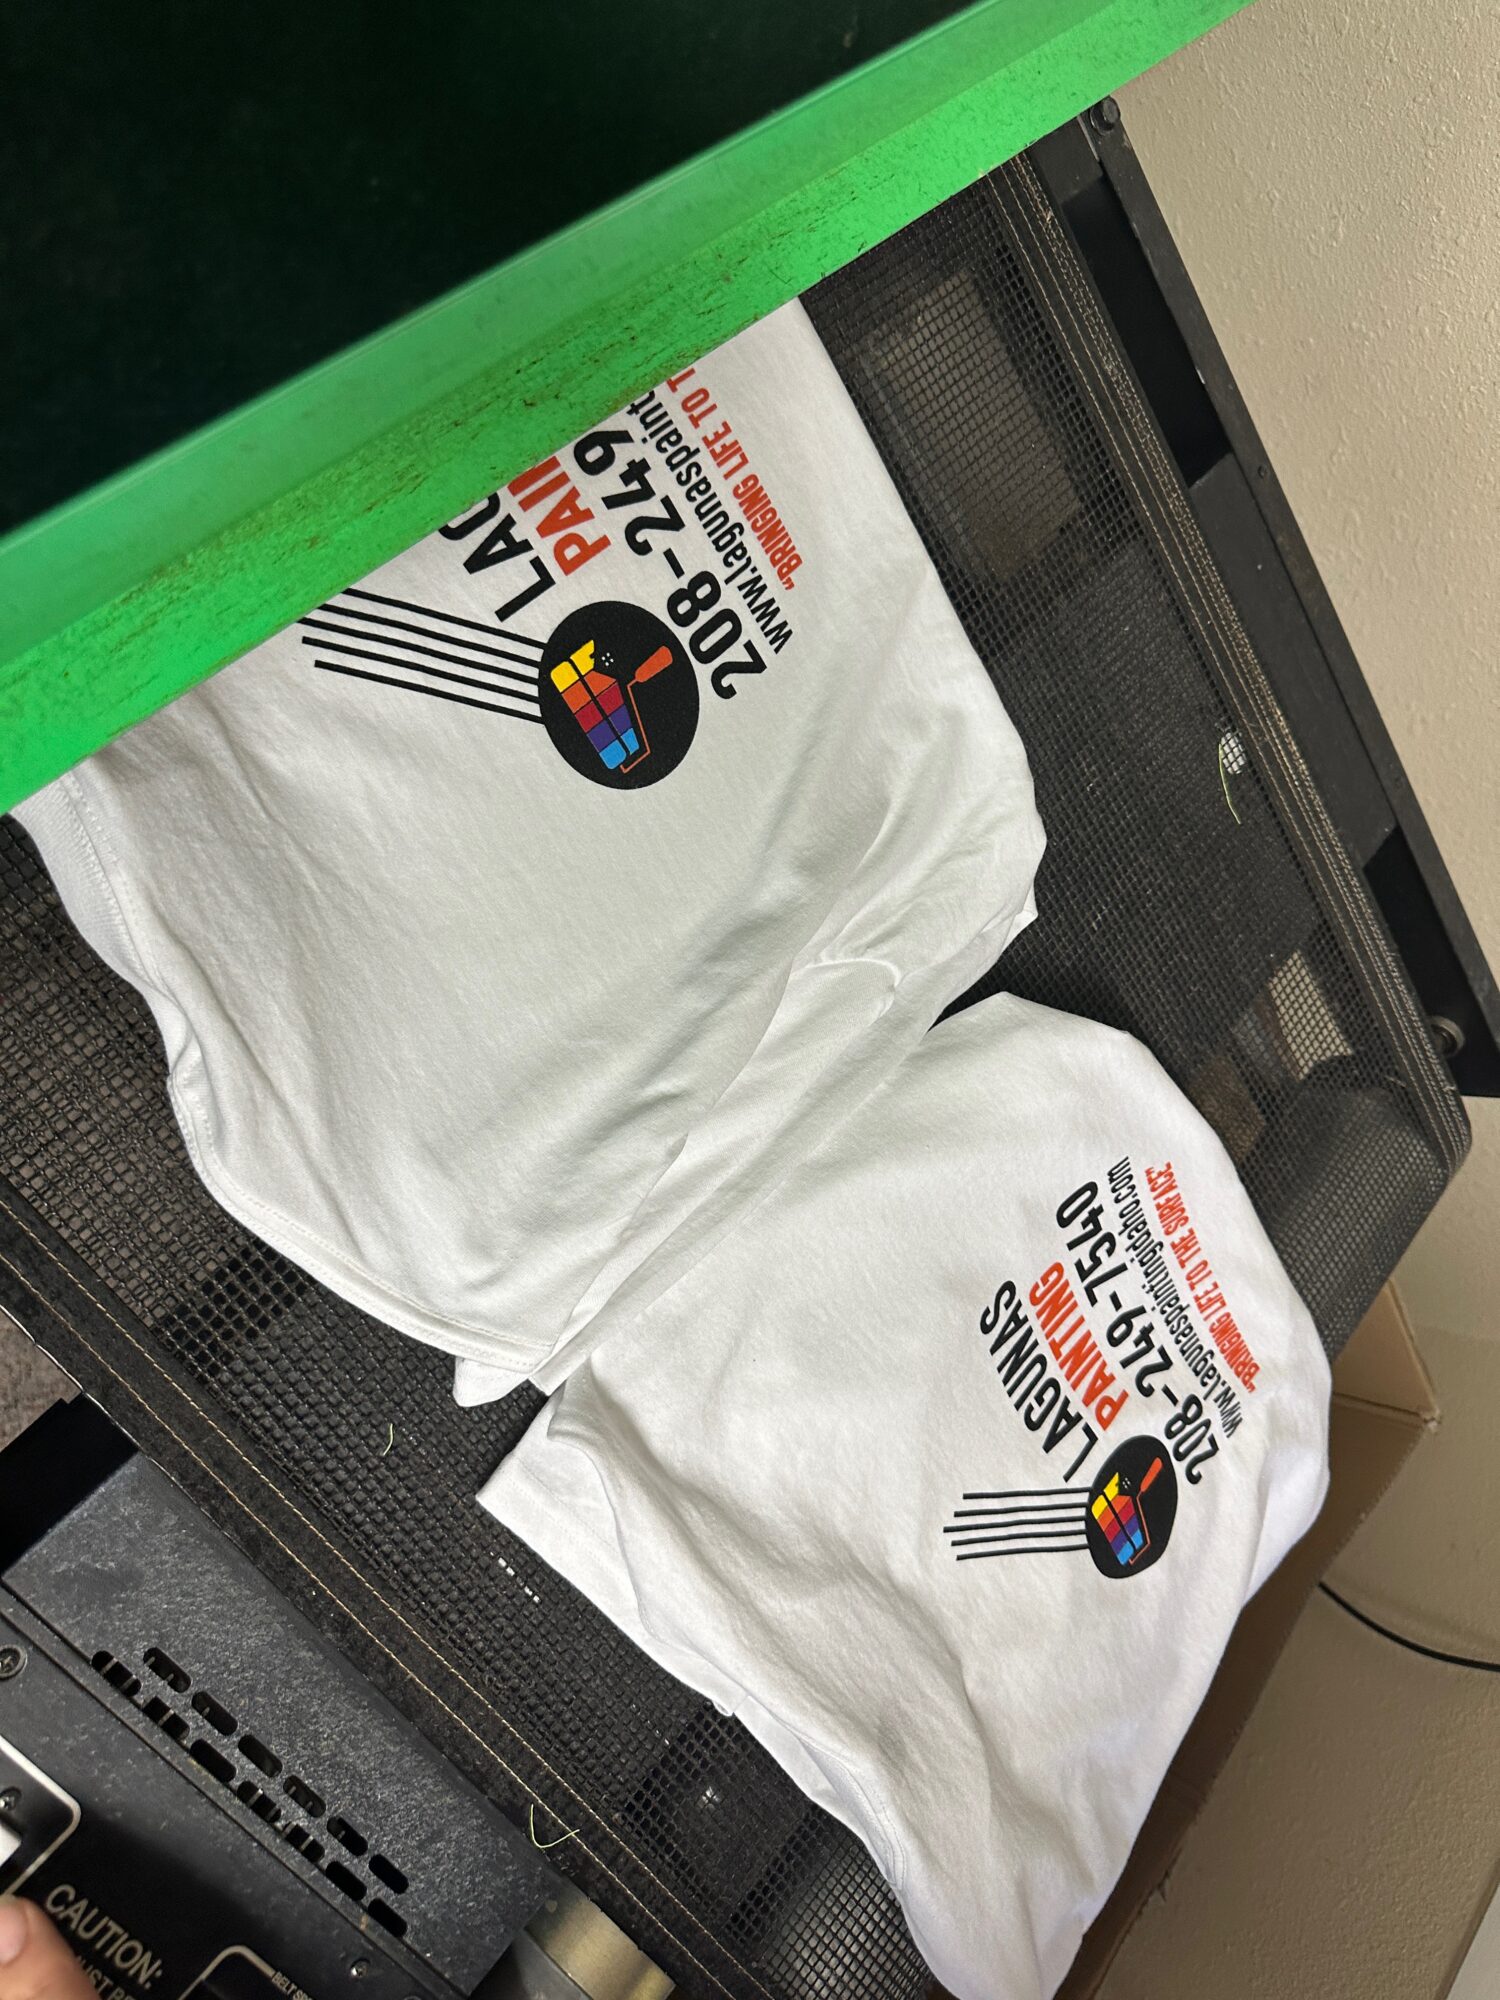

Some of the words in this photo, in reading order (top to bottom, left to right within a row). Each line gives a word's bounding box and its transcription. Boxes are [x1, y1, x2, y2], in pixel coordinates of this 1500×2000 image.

[681, 387, 718, 429] TO
[702, 421, 749, 480] LIFE
[1170, 1227, 1202, 1269] THE
[1107, 1156, 1244, 1438] www.lagunaspaintingidaho.com
[1185, 1259, 1213, 1291] TO
[1193, 1281, 1227, 1322] LIFE
[1029, 1261, 1130, 1432] PAINTING
[979, 1279, 1099, 1483] LAGUNAS
[45, 1884, 162, 1990] CAUTION:
[272, 1971, 298, 1996] BELT
